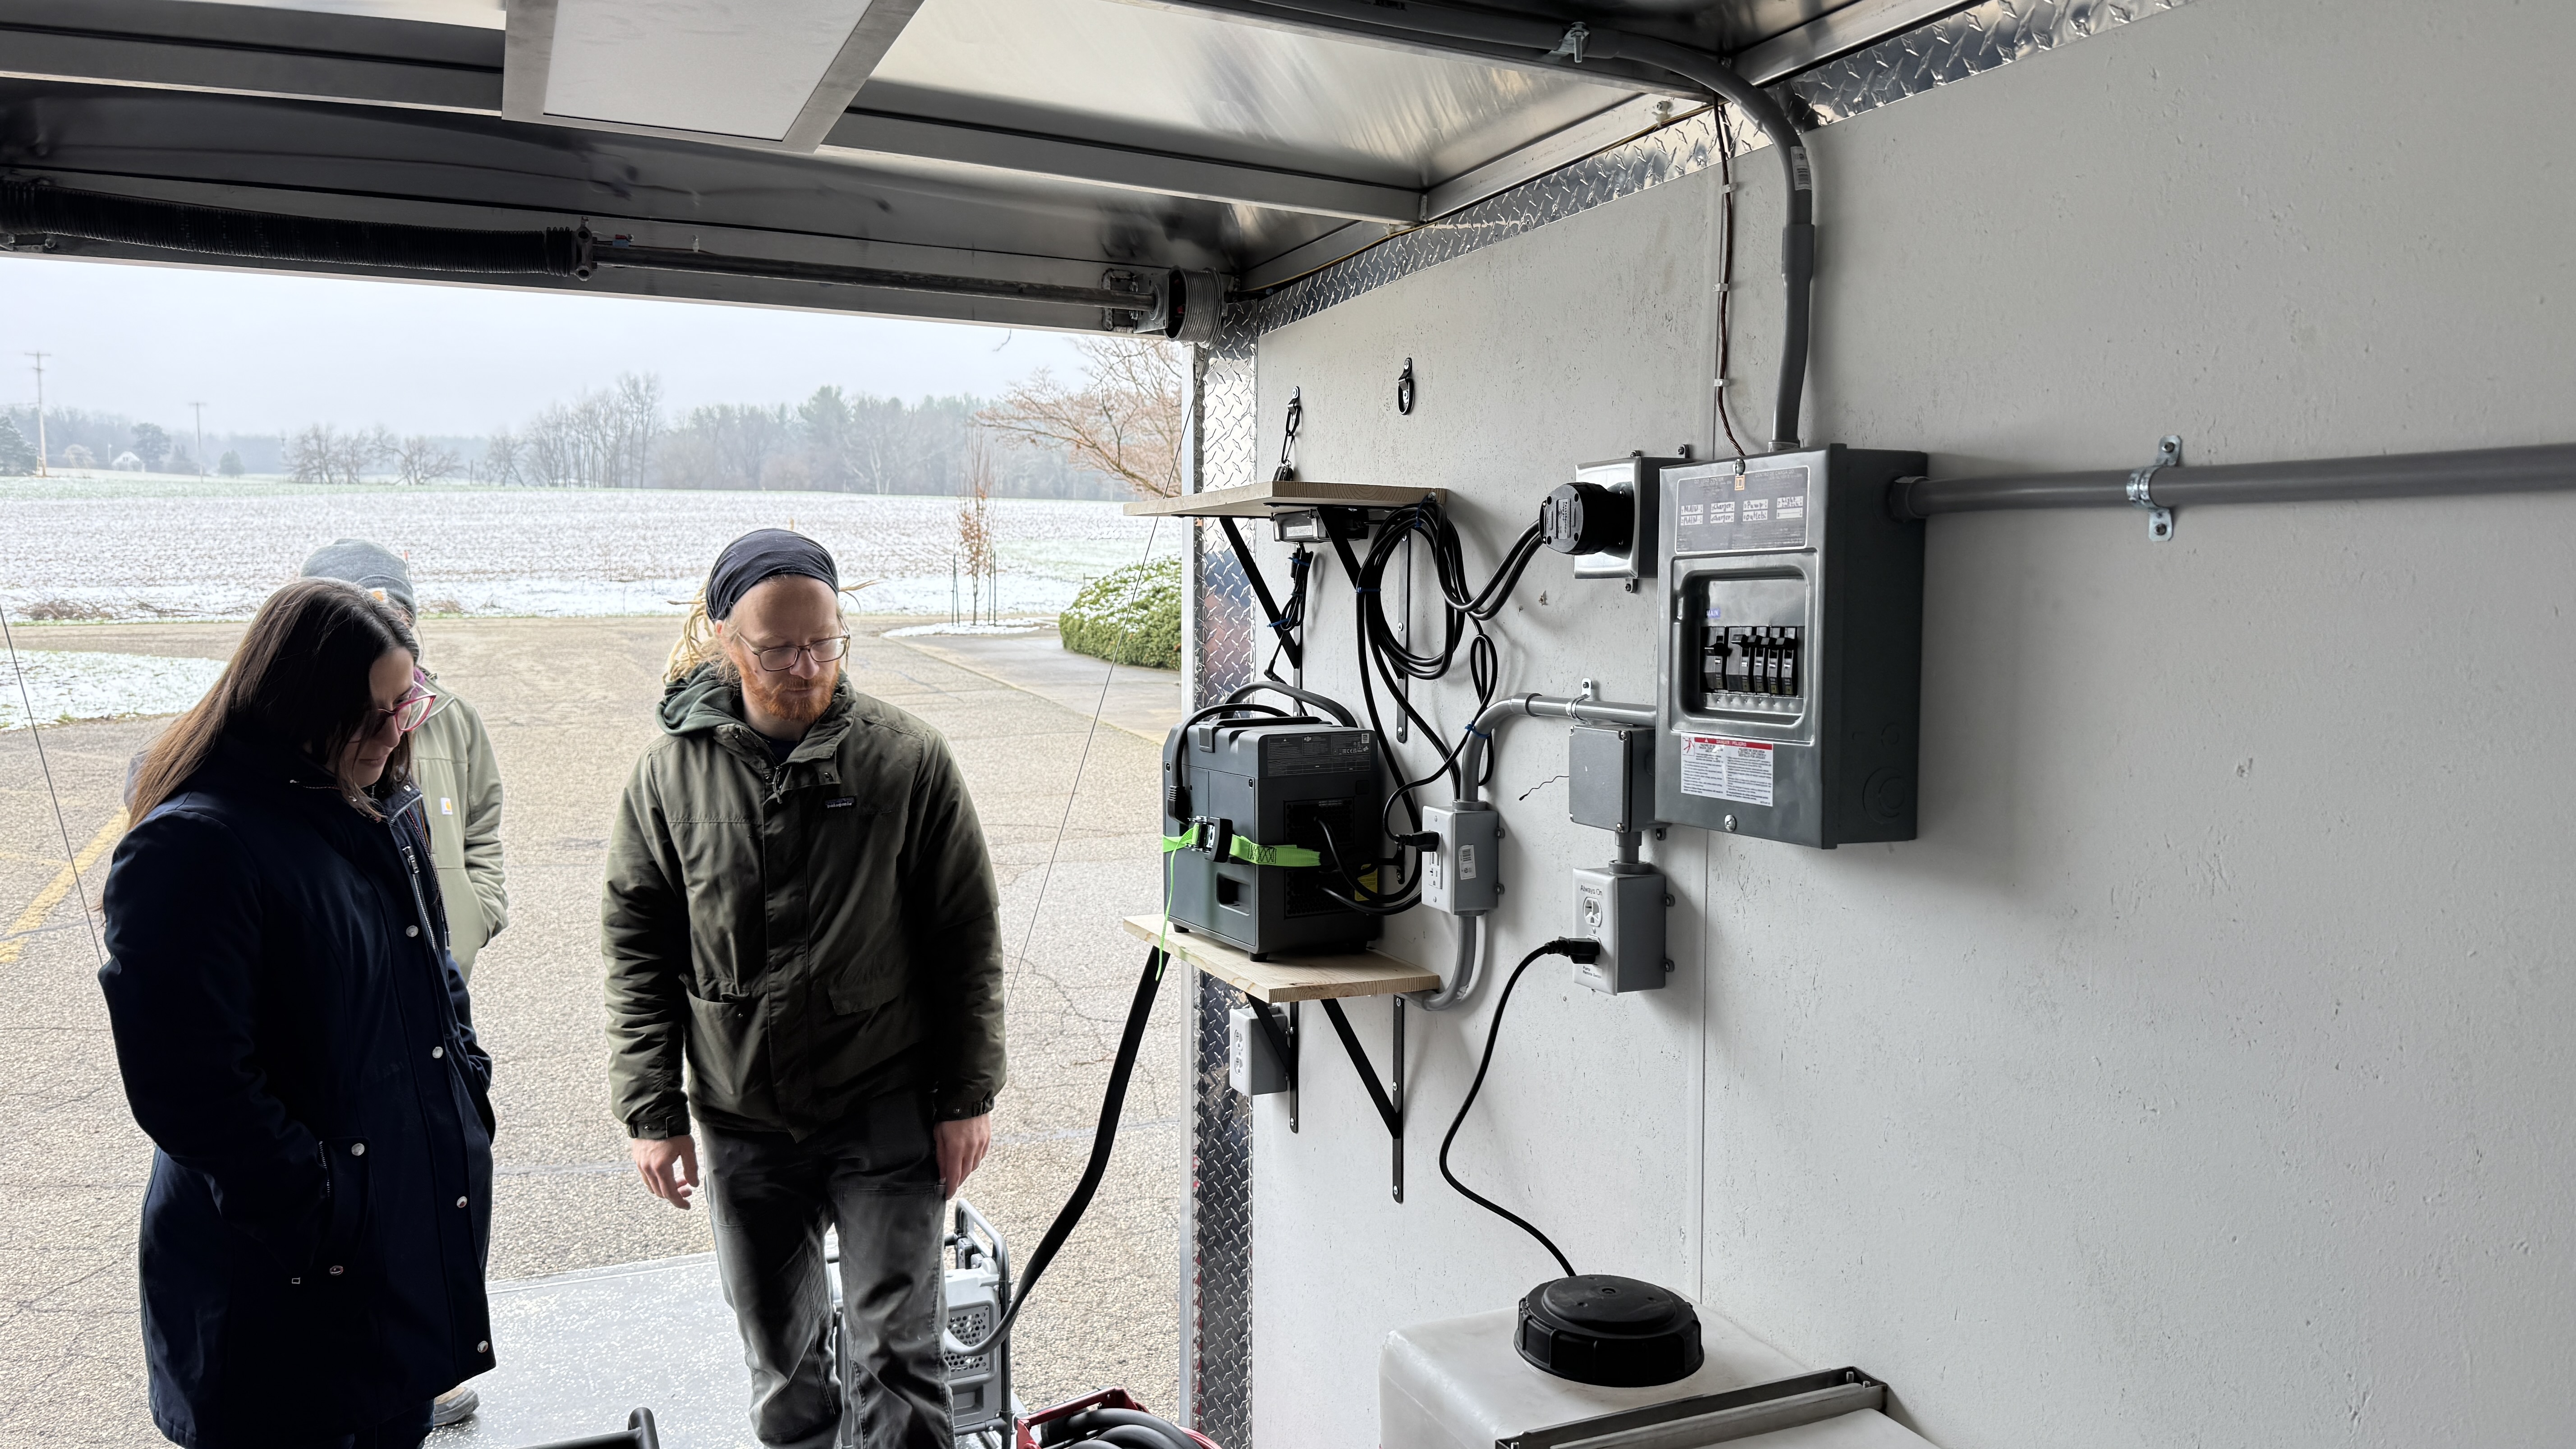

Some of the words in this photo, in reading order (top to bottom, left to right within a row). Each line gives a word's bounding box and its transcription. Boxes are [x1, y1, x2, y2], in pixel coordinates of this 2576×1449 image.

[1747, 501, 1763, 509] Pump
[1684, 515, 1697, 525] MAIN
[1580, 885, 1596, 894] Always
